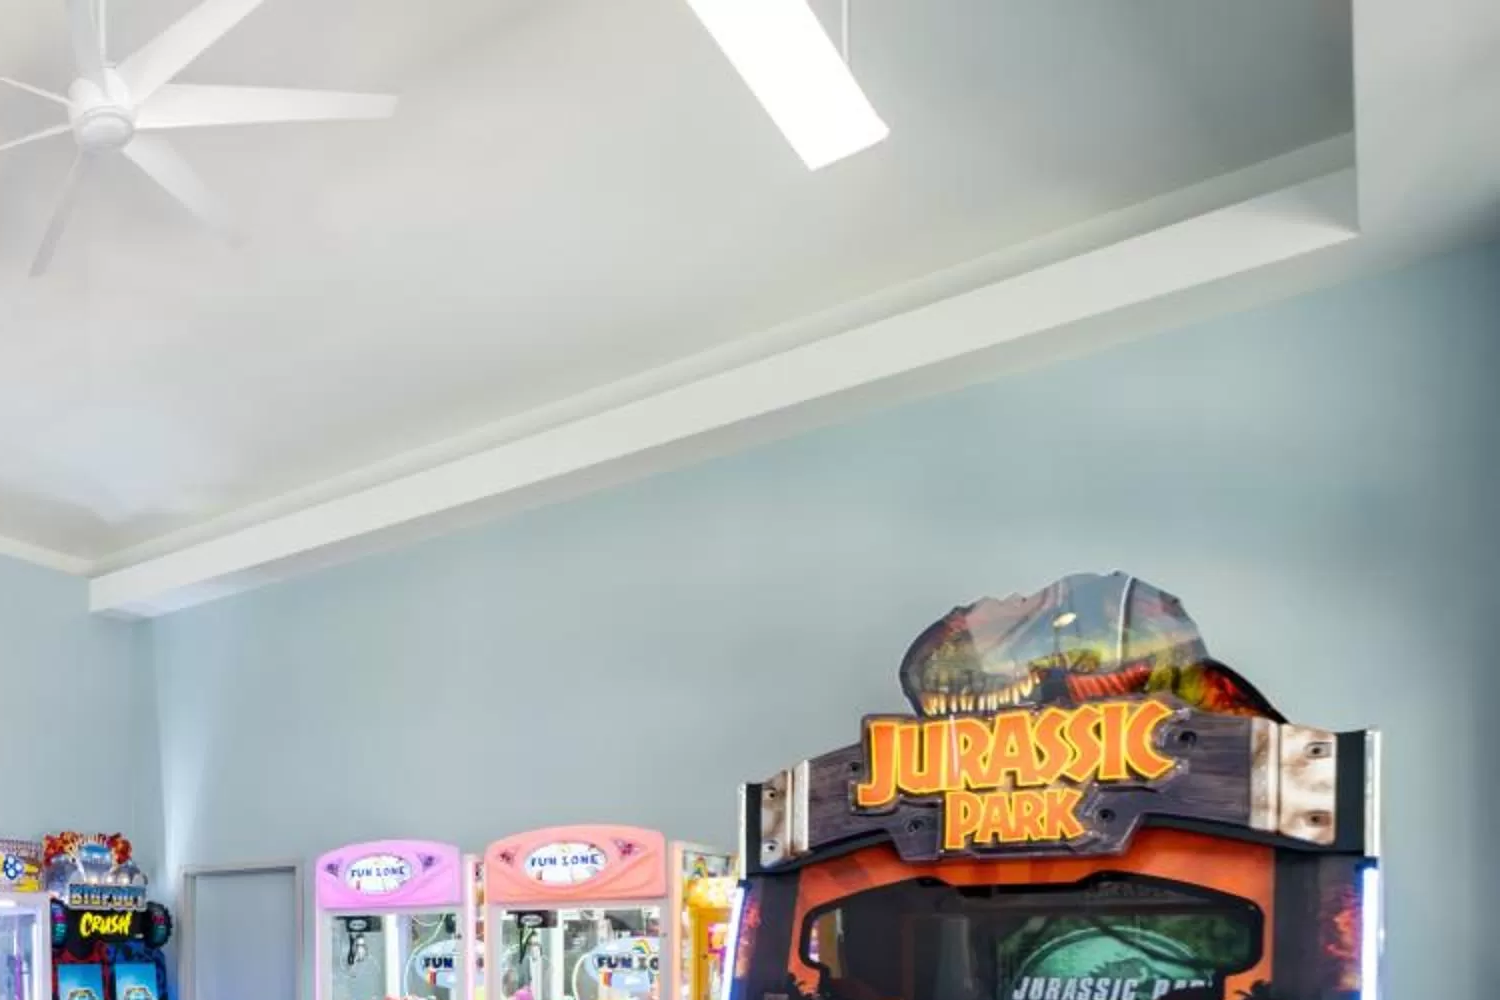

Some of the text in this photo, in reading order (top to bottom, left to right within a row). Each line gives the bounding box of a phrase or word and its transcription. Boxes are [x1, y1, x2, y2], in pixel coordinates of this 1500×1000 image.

[857, 701, 1175, 806] JURASSIC
[944, 787, 1086, 850] PARK
[80, 911, 133, 939] CRUSH
